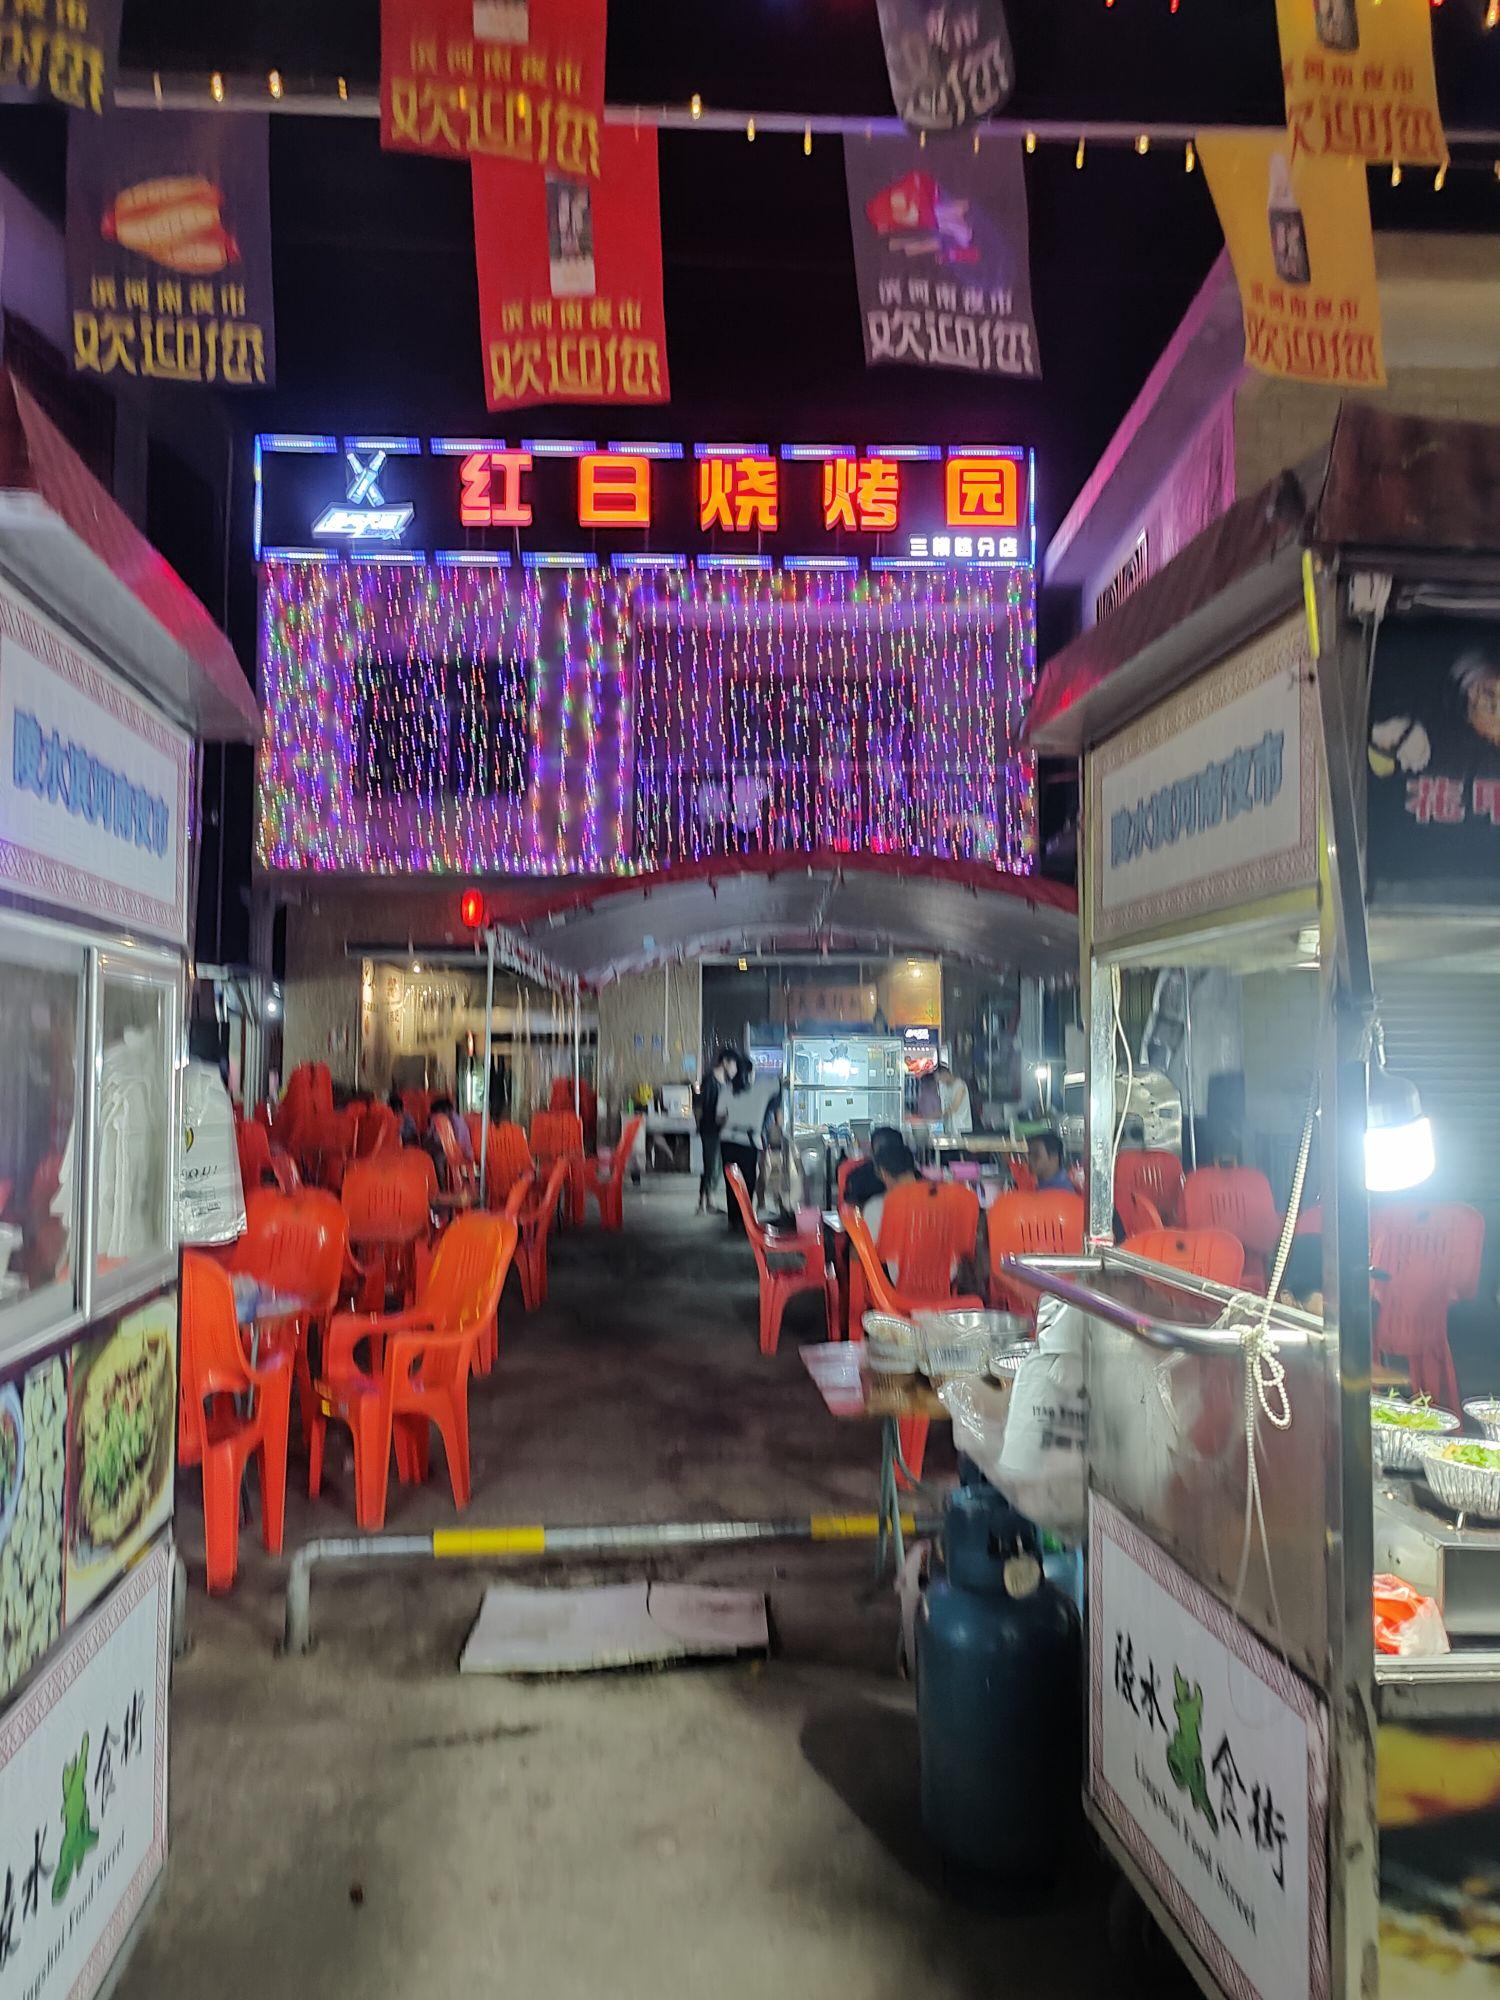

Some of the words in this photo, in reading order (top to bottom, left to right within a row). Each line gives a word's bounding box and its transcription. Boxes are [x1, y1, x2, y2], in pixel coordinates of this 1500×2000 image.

[391, 78, 600, 177] 欢迎您
[73, 309, 266, 384] 欢迎您
[490, 334, 661, 400] 欢迎您
[867, 308, 1034, 375] 欢迎您
[1247, 312, 1379, 383] 欢迎您
[460, 450, 1018, 532] 红日烧烤园
[69, 1876, 94, 1938] Food
[97, 1825, 125, 1888] Street
